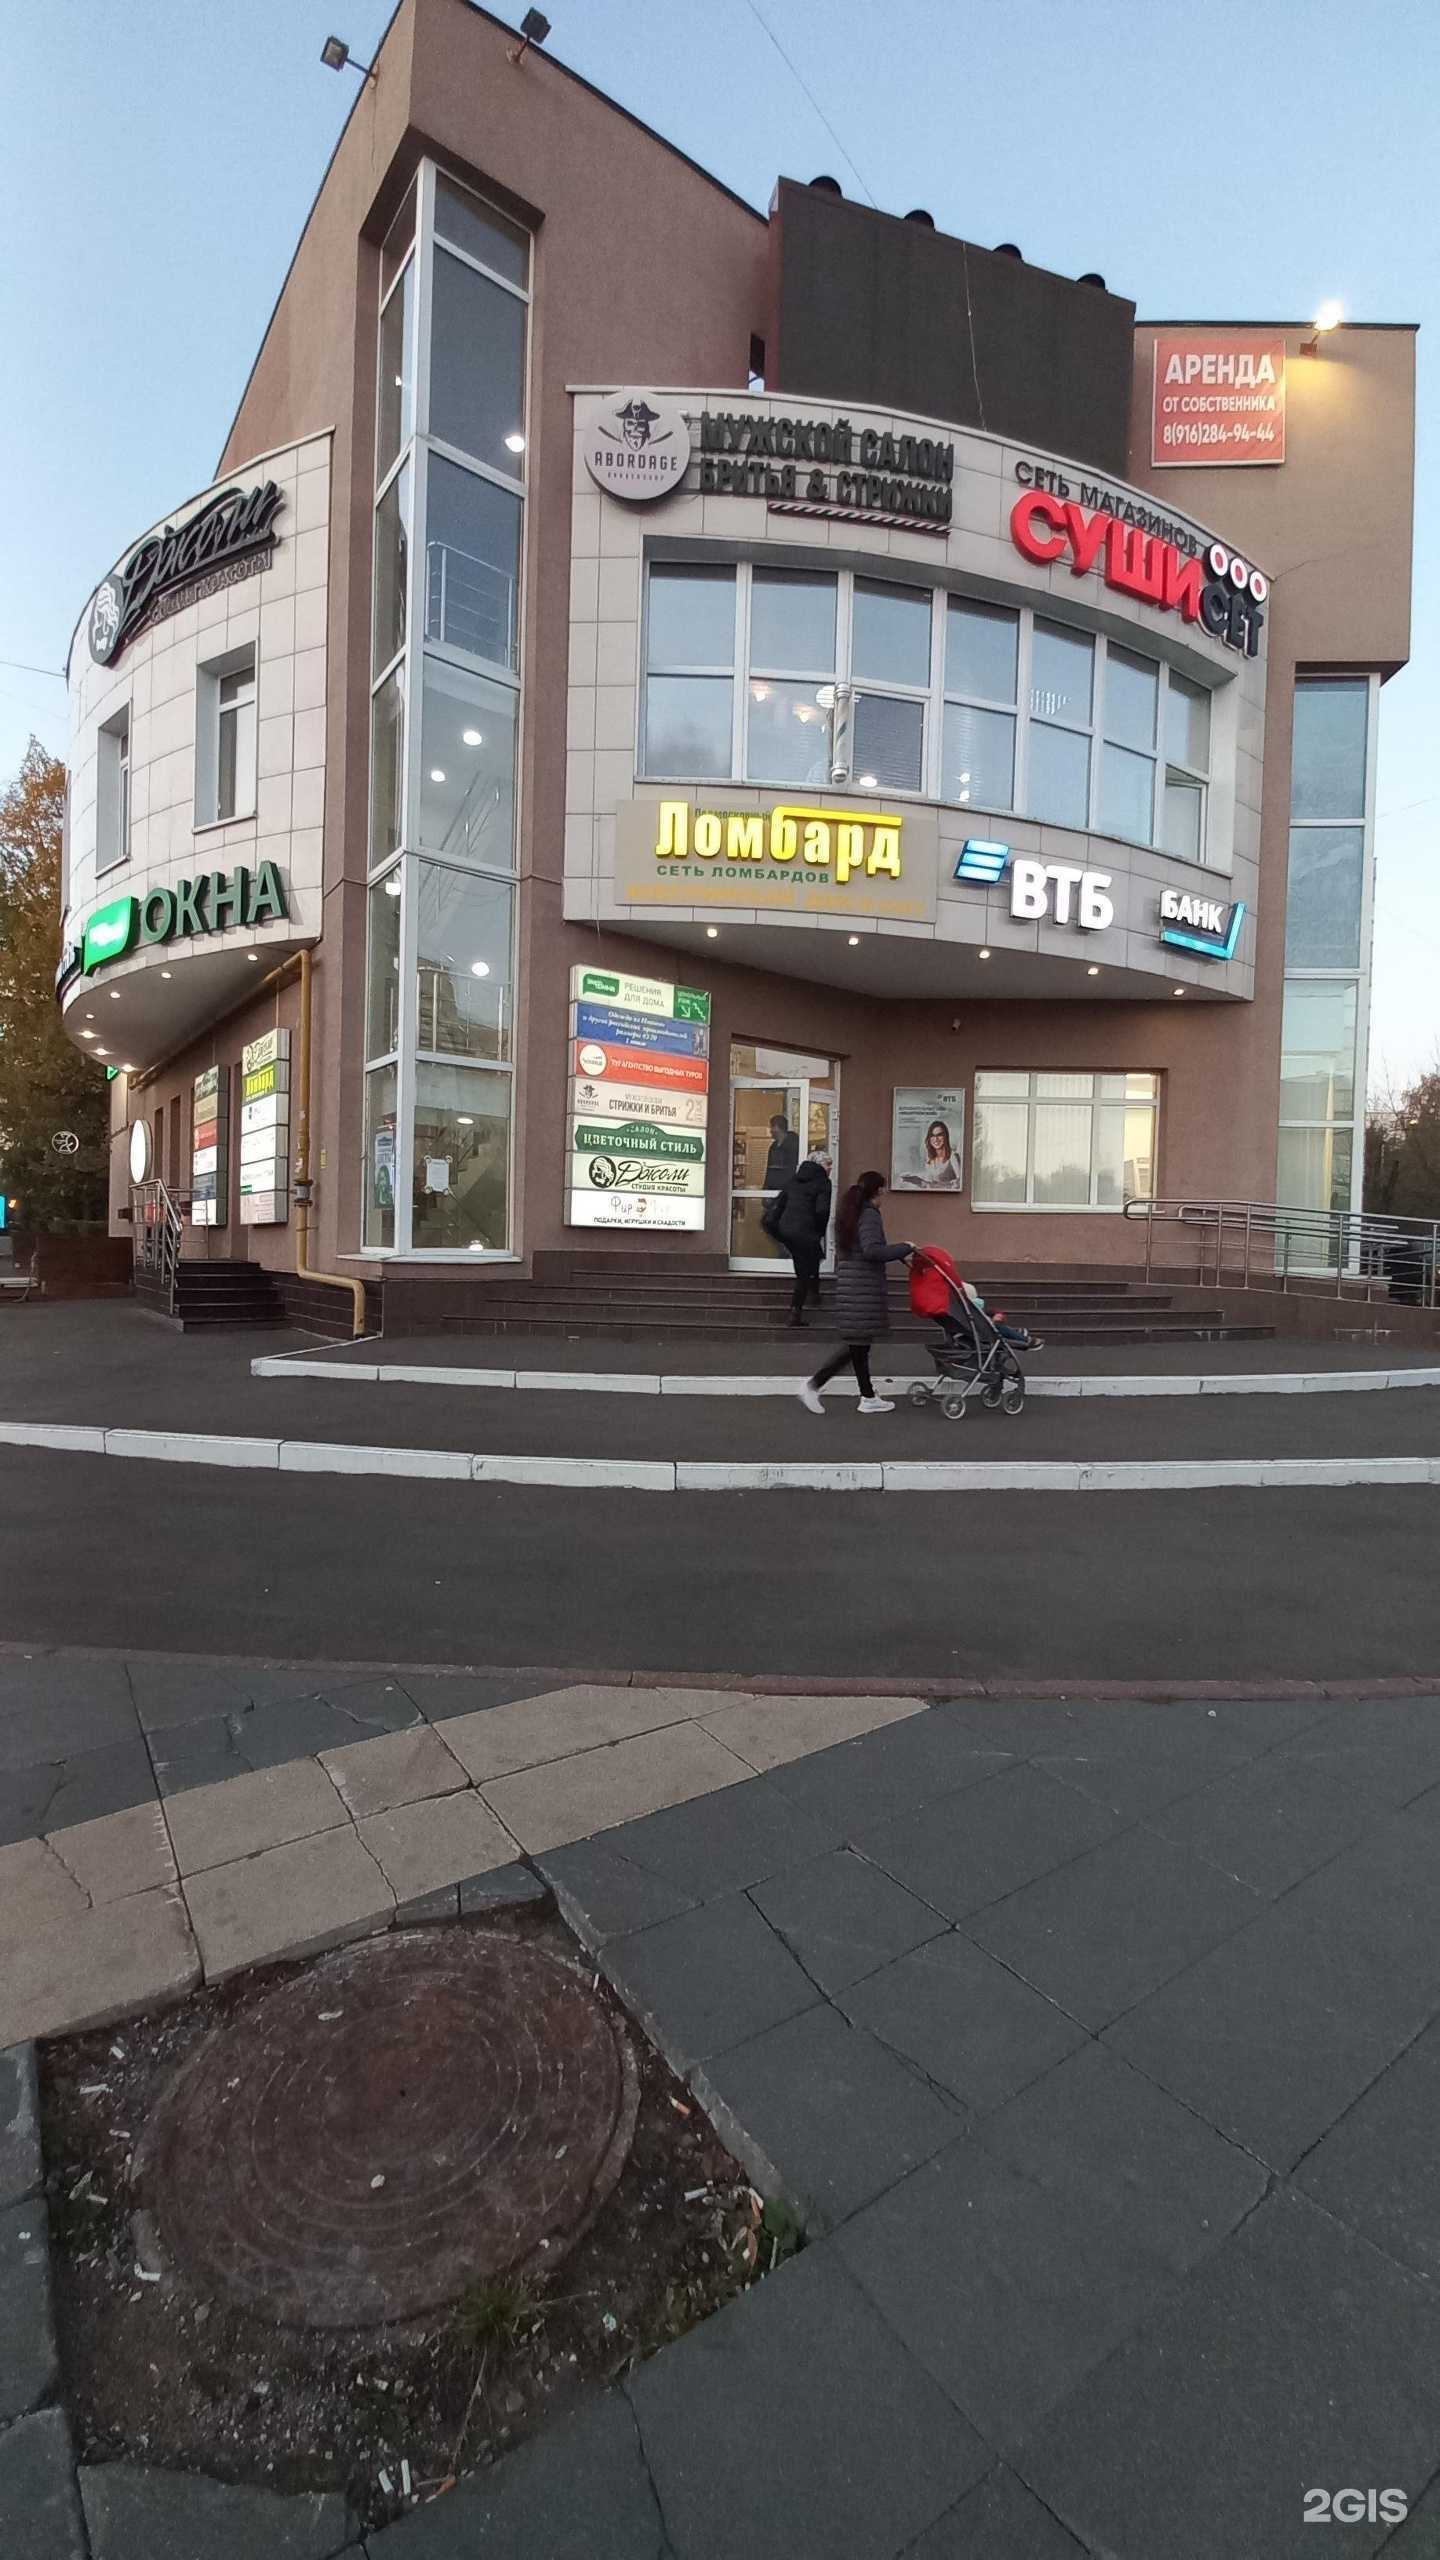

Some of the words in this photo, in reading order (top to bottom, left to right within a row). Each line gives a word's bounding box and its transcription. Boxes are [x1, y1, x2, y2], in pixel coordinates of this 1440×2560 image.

[1163, 353, 1276, 389] АРЕНДА
[1162, 396, 1180, 413] ОТ
[1181, 395, 1276, 412] СОБСТВЕННИКА
[700, 411, 852, 465] МУЖСКОЙ
[860, 427, 955, 482] САЛОН
[1163, 421, 1275, 447] 8(916)284-94-44
[594, 451, 678, 472] ABORDAGE
[700, 457, 797, 497] БРИТЬЯ
[806, 470, 828, 500] &
[836, 470, 953, 521] СТРИЖКИ
[1014, 460, 1070, 498] СЕТЬ
[1080, 481, 1198, 556] МАГАЗИНОВ
[655, 800, 903, 885] Ломбард
[656, 864, 705, 877] СЕТЬ
[711, 866, 830, 884] ЛОМБАРДОВ
[140, 860, 289, 945] ОКНА
[1010, 859, 1114, 930] ВТБ
[1160, 889, 1225, 934] БАНК
[608, 1099, 643, 1113] СТРИЖКИ
[644, 1103, 650, 1114] И
[651, 1104, 677, 1118] БРИТЬЯ
[583, 1133, 657, 1151] ЦВЕТОЧНЫЙ
[660, 1140, 697, 1154] СТИЛЬ
